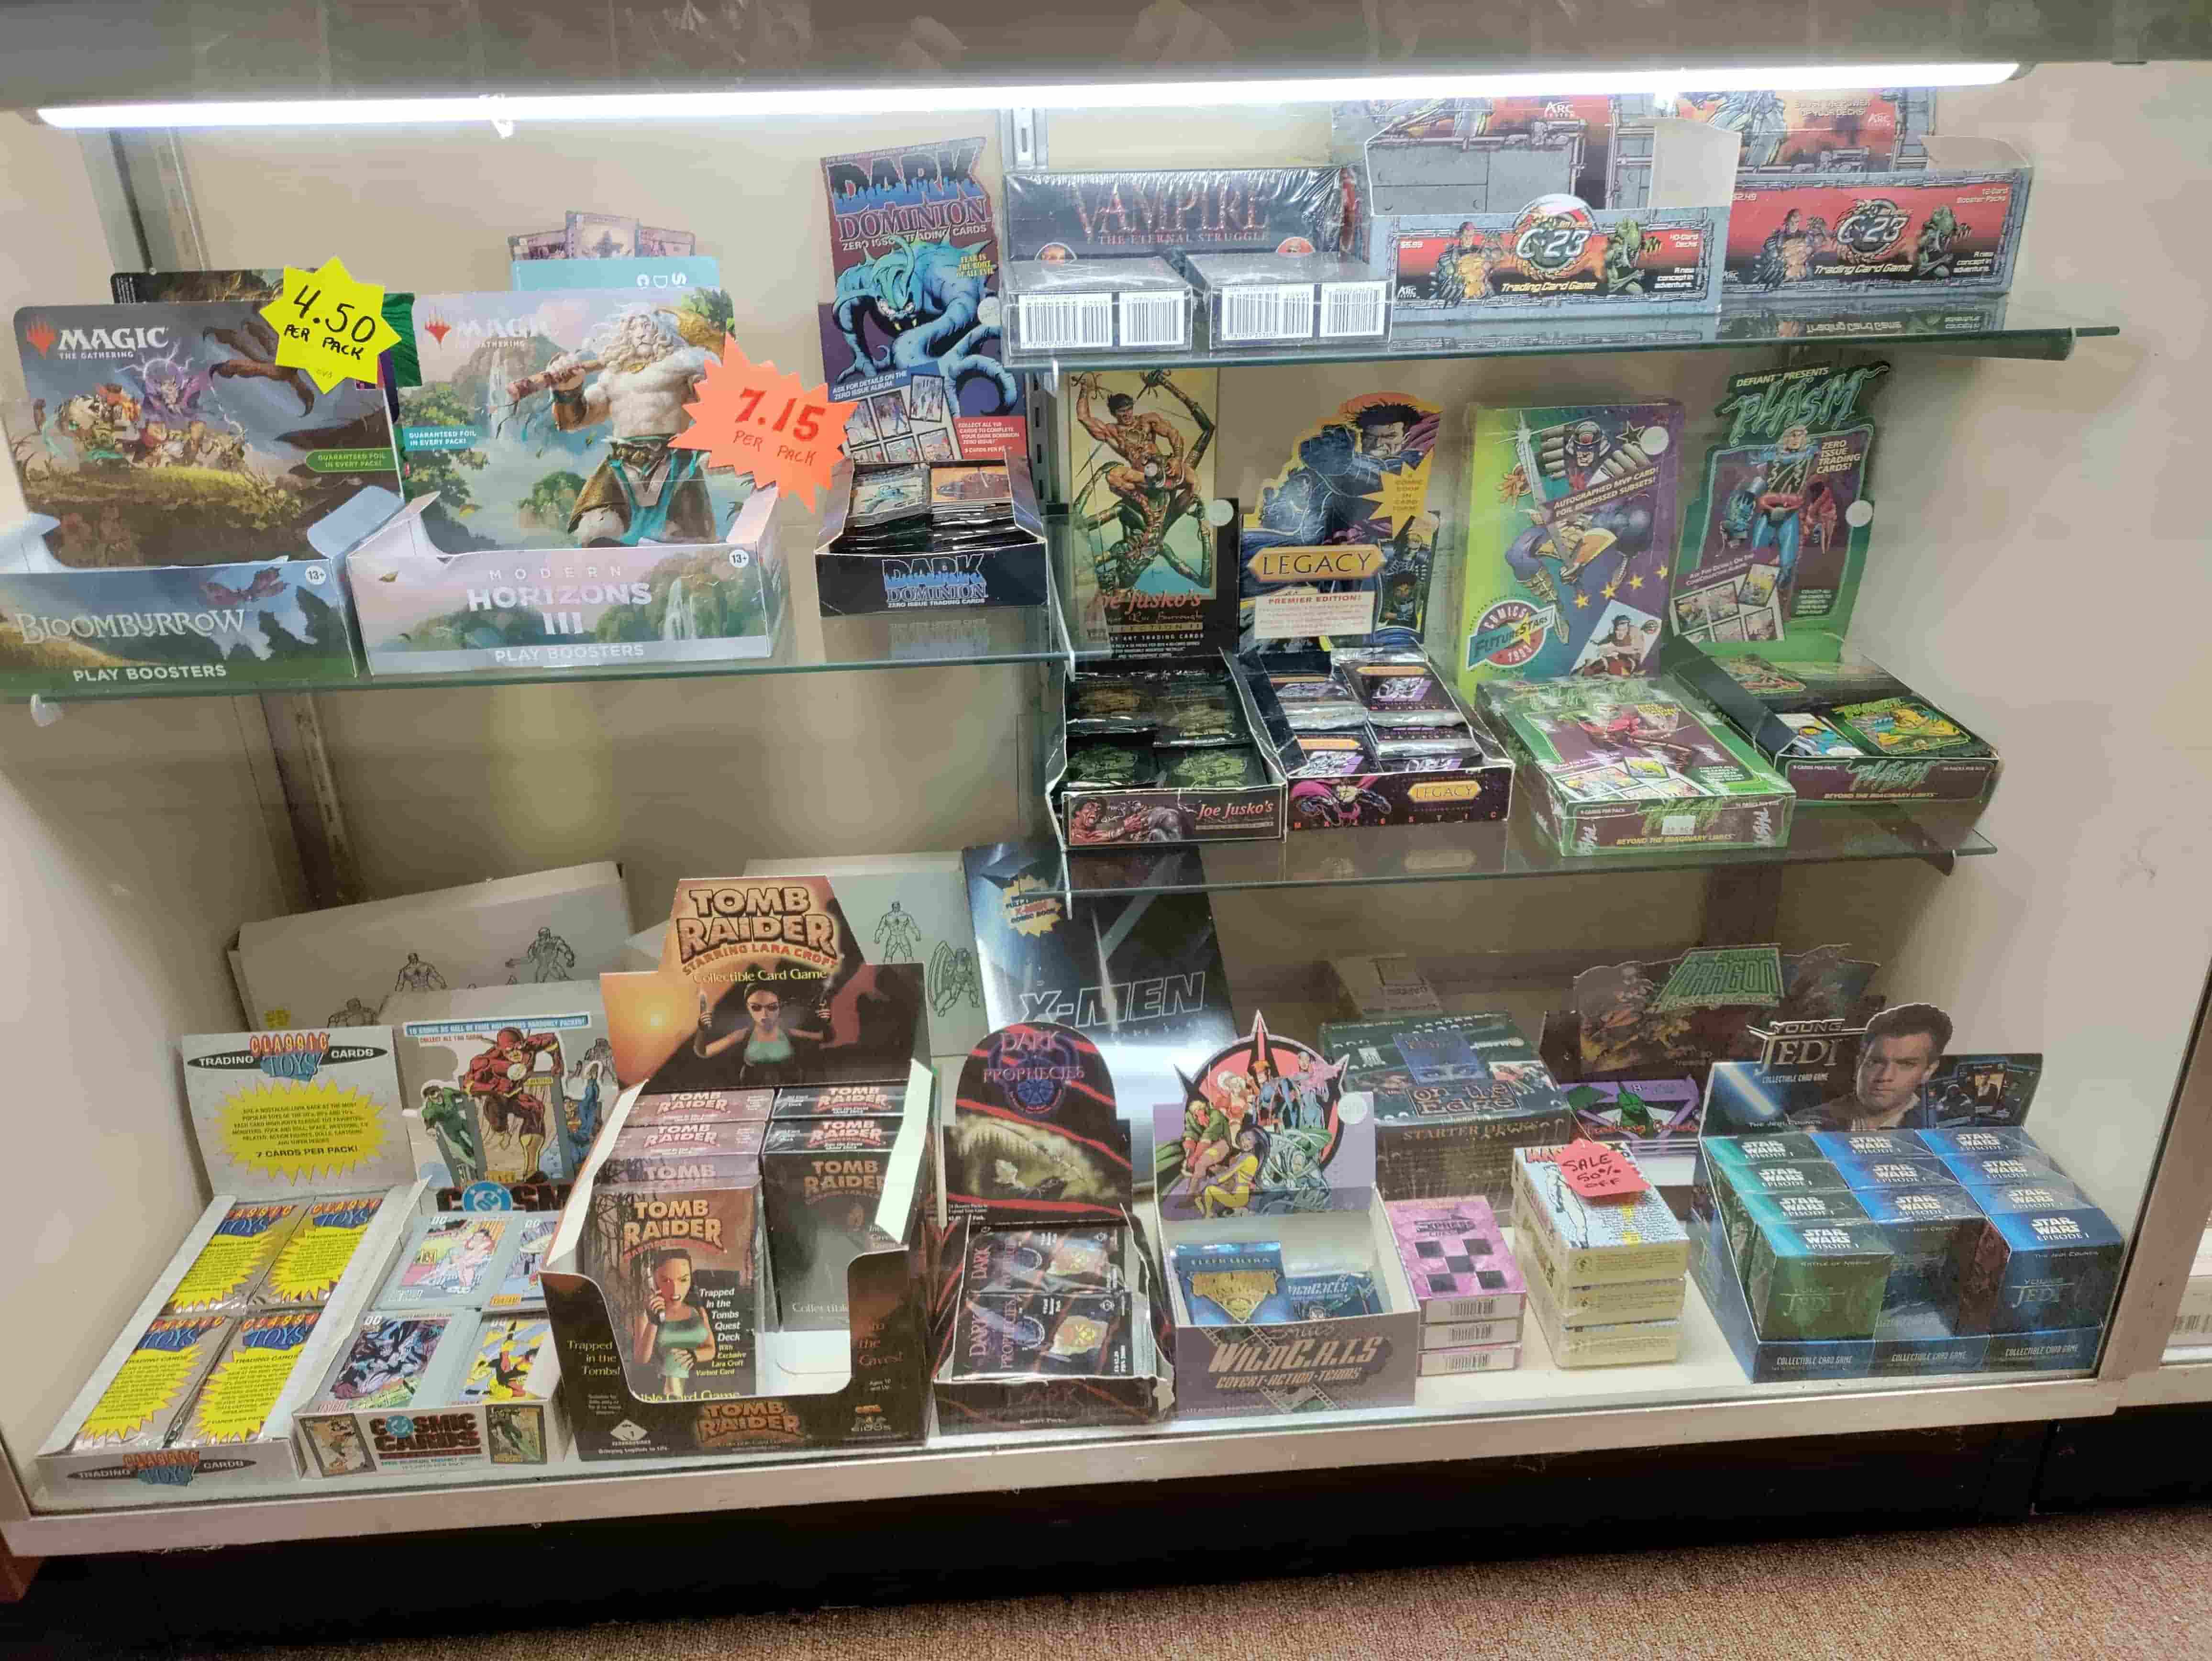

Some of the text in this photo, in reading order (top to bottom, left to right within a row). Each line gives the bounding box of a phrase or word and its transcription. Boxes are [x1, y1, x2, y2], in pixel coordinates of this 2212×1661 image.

[1545, 102, 1573, 114] ARC
[827, 147, 984, 215] DARK
[1073, 186, 1271, 233] VAMPIRE
[837, 197, 989, 241] DOMINION
[842, 225, 987, 251] ZERO CARDS
[1098, 232, 1270, 244] THE ETERNAL STRUGGLE
[1814, 264, 1912, 276] Trading Card Game
[1501, 281, 1596, 293] Trading Card Game
[294, 285, 375, 343] 4.50
[58, 325, 168, 351] MAGIC
[284, 323, 309, 342] PER
[322, 336, 365, 360] PACK
[81, 351, 134, 360] GATHERING
[1736, 367, 1829, 388] DEFIANT PRESENTS
[1723, 368, 1868, 443] PLASM
[735, 388, 826, 442] 7.15
[735, 430, 762, 451] PER
[1822, 440, 1847, 450] ZERO
[778, 444, 817, 465] PACK
[1821, 448, 1848, 457] ISSUE
[1818, 453, 1860, 466] TRADING
[1816, 462, 1853, 474] CARDS!
[1553, 476, 1634, 510] AUTOGRAPHED MVP
[1555, 506, 1573, 518] FOIL
[731, 553, 748, 564] 13+
[1262, 551, 1372, 576] LEGACY
[308, 570, 325, 581] 13+
[488, 566, 622, 579] MODERN
[882, 554, 987, 587] DARK
[467, 582, 653, 612] HORIZONS
[887, 584, 988, 603] DOMINION
[1268, 596, 1312, 605] PREMIER
[542, 612, 584, 635] III
[1484, 606, 1527, 629] COMICS
[494, 644, 645, 663] PLAY BOOSTERS
[73, 664, 227, 682] PLAY BOOSTERS
[1415, 786, 1474, 799] LEGACY
[1197, 799, 1274, 819] Joe Jusko's
[689, 886, 812, 918] TOMB
[676, 914, 839, 964] RAIDER
[682, 943, 839, 976] STARRING LARA CROFT
[693, 968, 827, 985] Collectible Card Game
[1018, 972, 1206, 1028] X-MEN
[1773, 1021, 1843, 1033] YOUNG
[248, 1032, 330, 1053] CLASSIC
[1001, 1030, 1060, 1052] DARK
[331, 1047, 375, 1059] CARDS
[1753, 1037, 1843, 1076] JEDI
[199, 1055, 254, 1066] TRADING
[265, 1054, 322, 1078] TOYS
[983, 1065, 1085, 1084] PROPHECIES
[1762, 1073, 1830, 1084] COLLECTIBLE CARD GAME
[671, 1091, 721, 1101] TOMB
[828, 1087, 880, 1095] TOMB
[657, 1099, 728, 1114] RAIDER
[818, 1094, 888, 1106] RAIDER
[657, 1123, 712, 1133] TOMB
[822, 1120, 875, 1129] TOMB
[643, 1132, 717, 1147] RAIDER
[811, 1128, 882, 1141] RAIDER
[1402, 1126, 1478, 1141] STARTER
[1956, 1132, 1998, 1141] STAR
[1742, 1140, 1783, 1148] STAR
[265, 1145, 358, 1157] CARDS PER PACK!
[812, 1160, 879, 1174] TOMB
[1562, 1152, 1613, 1172] SALE
[643, 1164, 716, 1179] TOMB
[1577, 1168, 1622, 1182] 50%
[1874, 1170, 1917, 1178] WARS
[1584, 1177, 1621, 1188] OFF
[634, 1199, 709, 1218] TOMB
[2032, 1217, 2077, 1227] STAR
[623, 1218, 723, 1243] RAIDER
[1803, 1229, 1848, 1237] STAR
[2034, 1224, 2081, 1235] WARS
[1804, 1235, 1851, 1244] WARS
[2036, 1233, 2082, 1241] EPISODE
[699, 1287, 735, 1298] Trapped
[717, 1299, 731, 1308] the
[711, 1310, 739, 1319] Tombs
[714, 1322, 741, 1331] Quest
[251, 1327, 307, 1347] TOYS
[718, 1333, 740, 1342] Deck
[859, 1336, 881, 1348] the
[566, 1340, 613, 1353] Trapped
[2005, 1345, 2061, 1356] COLLECTIBLE CARD
[586, 1354, 617, 1362] in the
[1776, 1354, 1853, 1367] COLLECTIBLE CARD GAME
[1891, 1350, 1967, 1362] COLLECTIBLE CARD GAME
[581, 1365, 621, 1375] Tombs!
[704, 1401, 785, 1418] TOMB
[697, 1416, 804, 1443] RAIDER
[78, 1460, 244, 1478] TRADING CARDS
